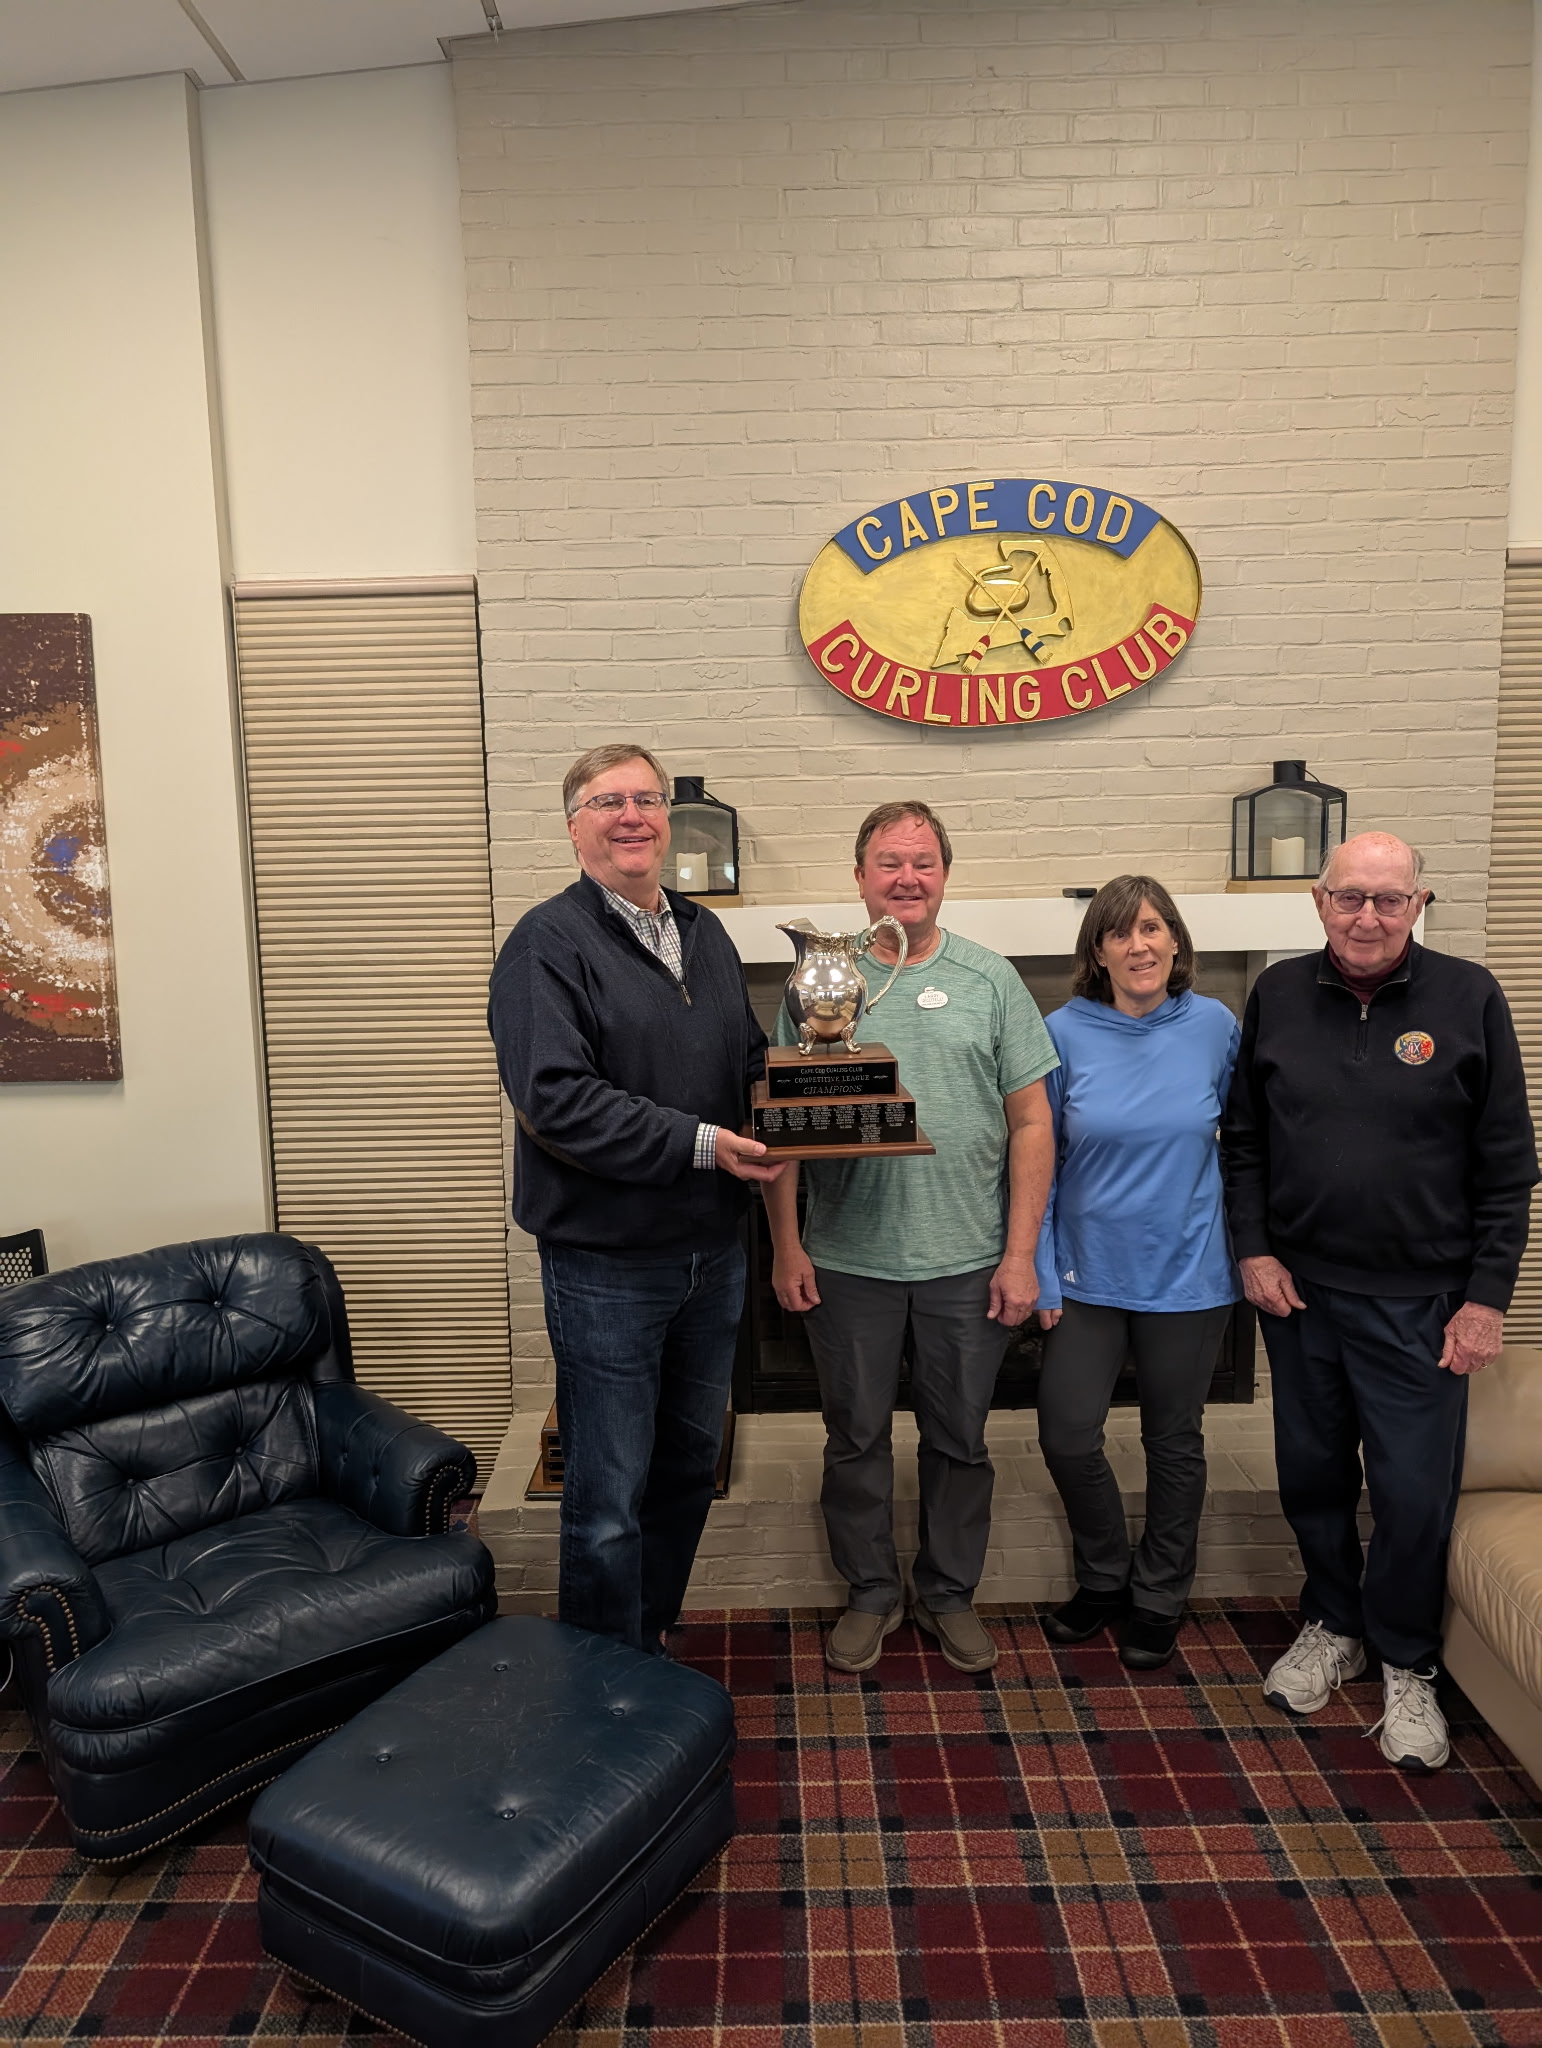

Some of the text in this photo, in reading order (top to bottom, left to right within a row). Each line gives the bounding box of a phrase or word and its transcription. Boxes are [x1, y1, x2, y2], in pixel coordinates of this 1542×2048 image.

[856, 482, 1134, 561] CAPE COD
[820, 613, 1188, 724] CURLING CLUB
[794, 1076, 840, 1084] COMPETITIVE
[803, 1085, 862, 1095] CHAMPIONS
